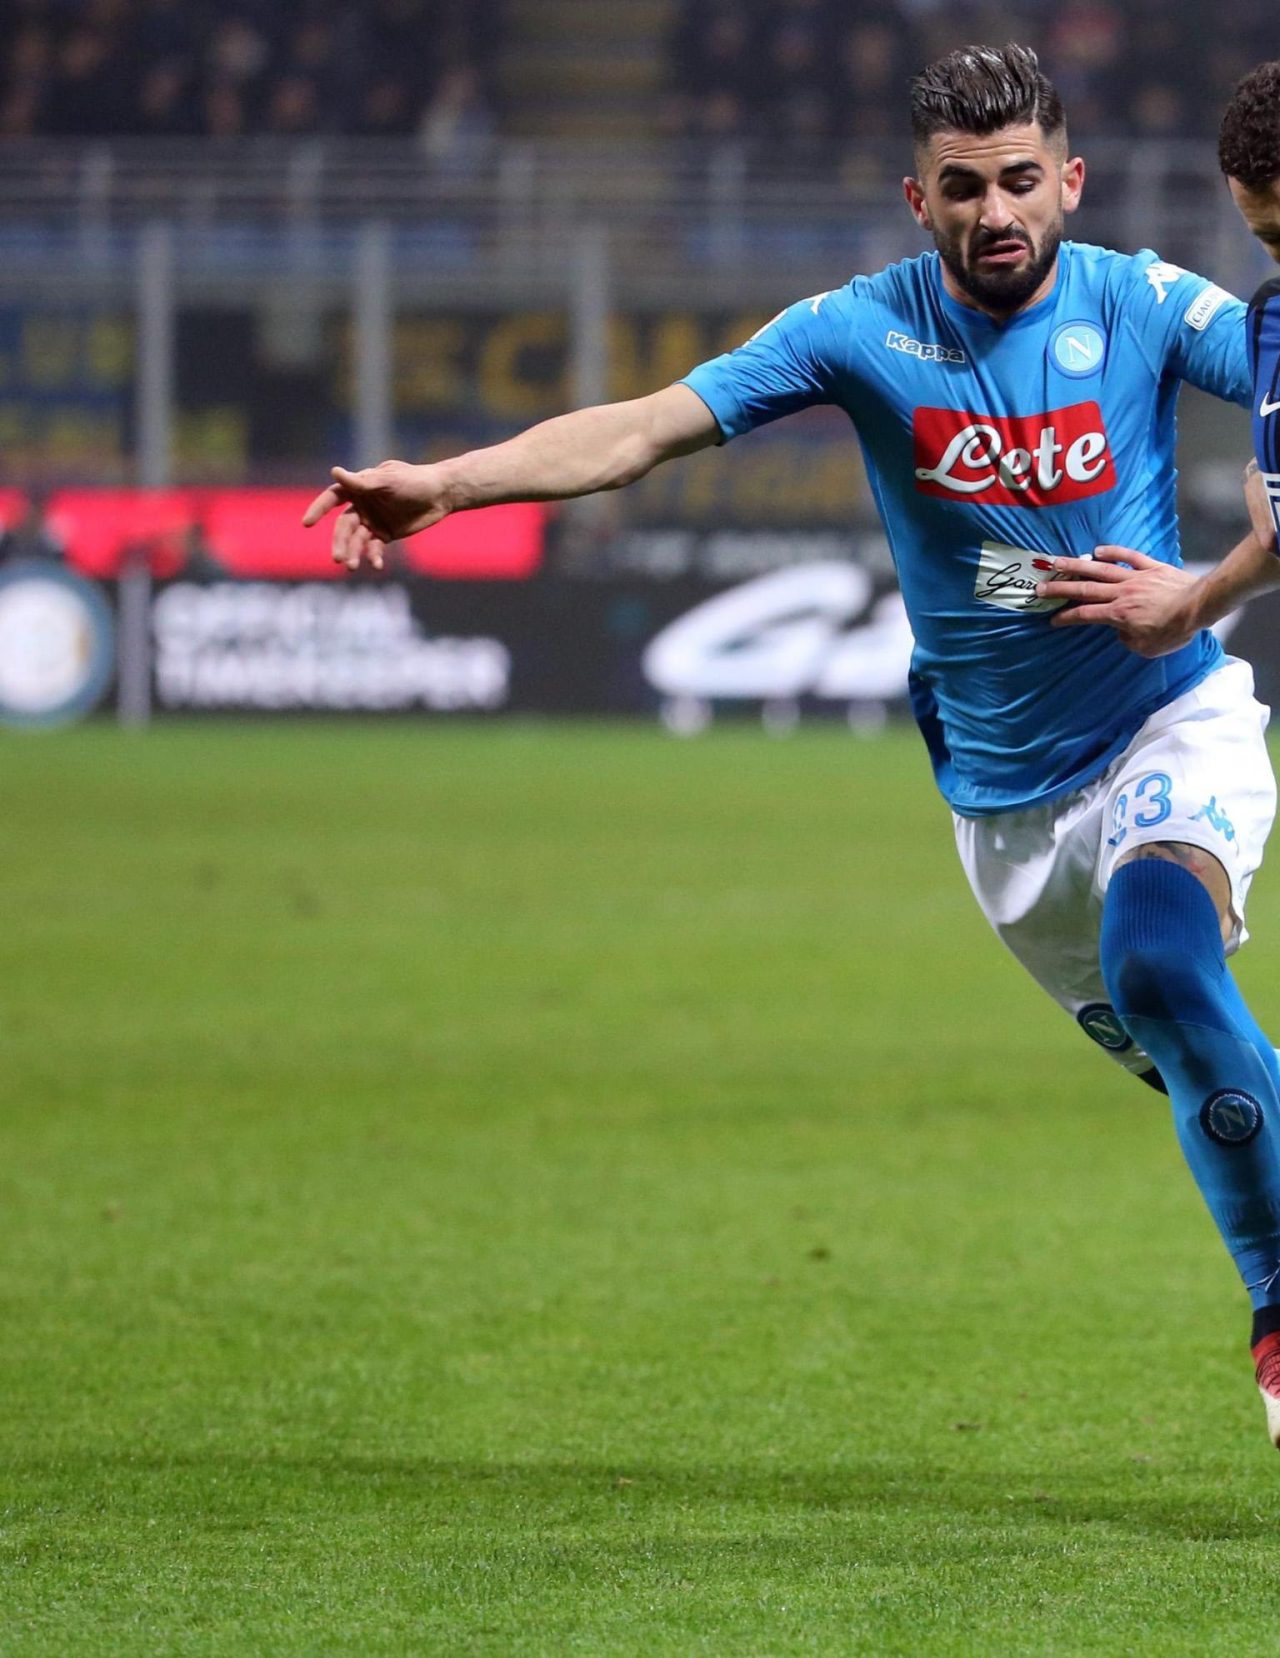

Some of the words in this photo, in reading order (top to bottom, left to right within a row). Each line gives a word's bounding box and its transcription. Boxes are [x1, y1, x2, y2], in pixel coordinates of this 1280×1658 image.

[886, 330, 966, 364] Kappa
[1065, 333, 1093, 364] N
[915, 424, 1106, 493] Lete
